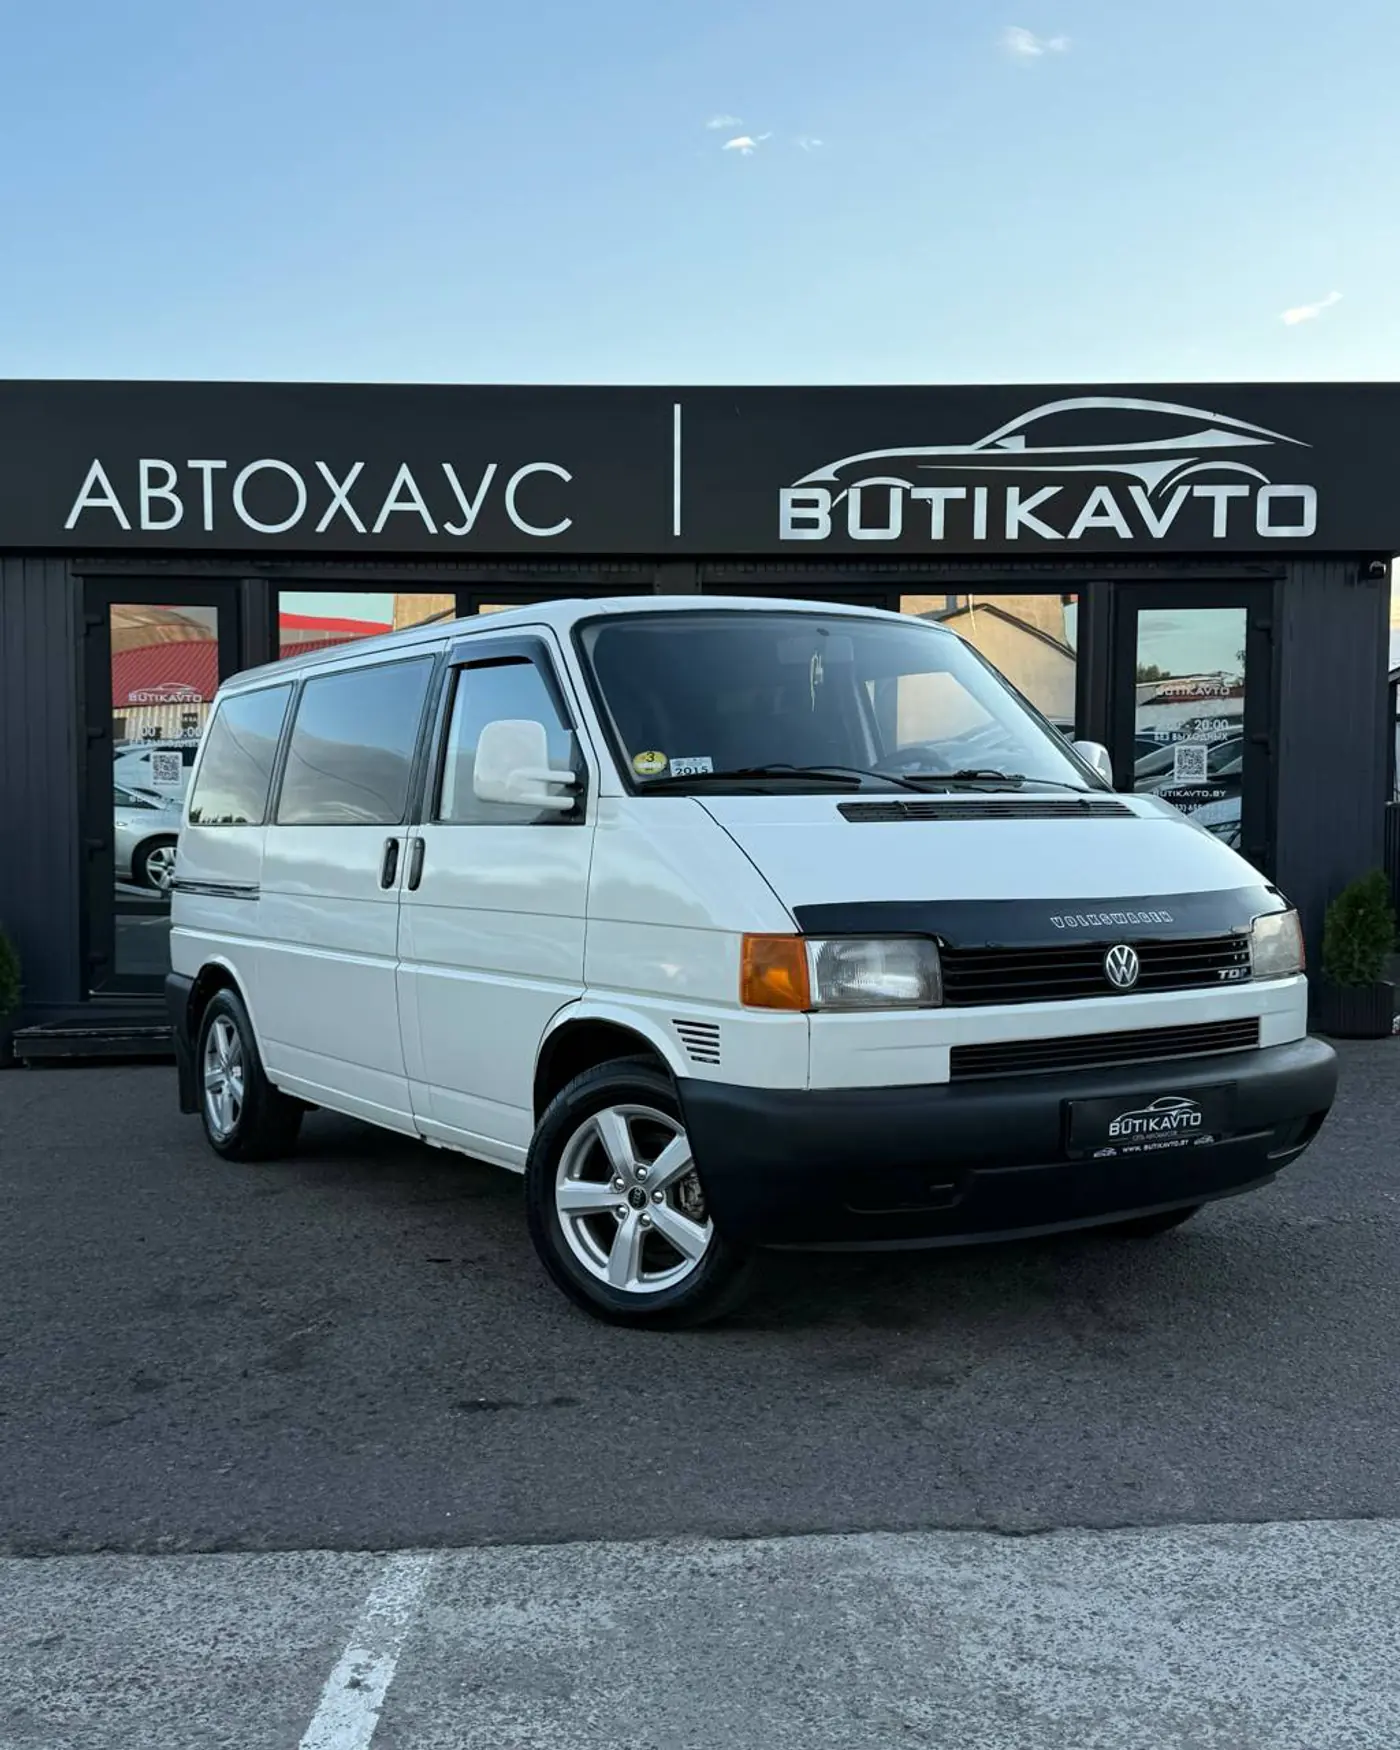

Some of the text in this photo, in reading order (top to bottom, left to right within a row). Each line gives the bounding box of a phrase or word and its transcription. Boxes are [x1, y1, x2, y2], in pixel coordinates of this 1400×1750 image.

[64, 458, 573, 537] АВТОХАУС
[778, 483, 1318, 541] BUTIKAVTO
[128, 692, 203, 702] BUTIKAVTO
[1194, 719, 1229, 731] 20:00
[645, 751, 655, 762] 3
[675, 765, 708, 776] 2015
[1050, 910, 1174, 929] VOLKSWAGEN
[1108, 1112, 1202, 1136] BUTIKAVTO
